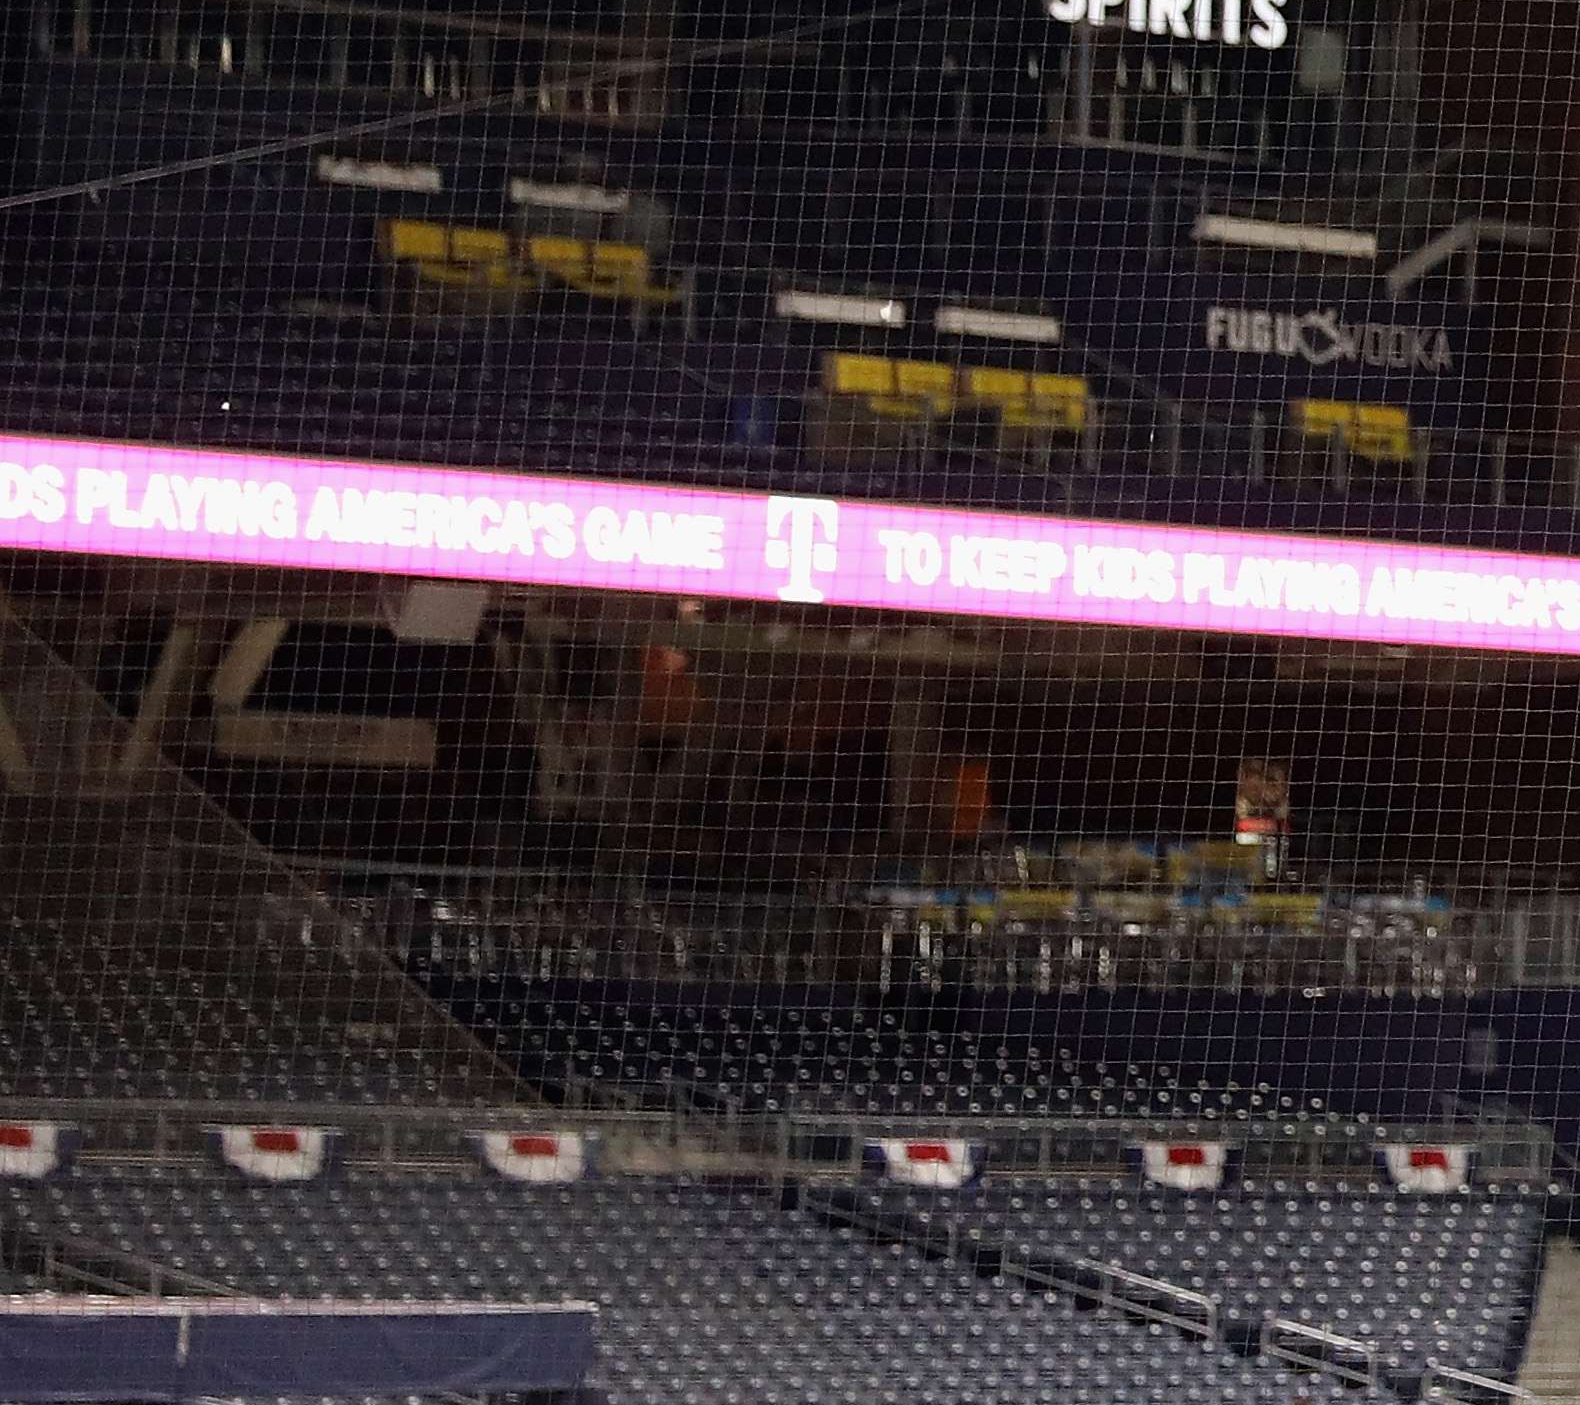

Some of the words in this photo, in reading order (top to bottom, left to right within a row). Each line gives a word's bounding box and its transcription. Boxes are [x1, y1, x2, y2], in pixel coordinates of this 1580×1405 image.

[1207, 306, 1301, 357] FUGU
[77, 468, 297, 539] PLAYING
[304, 486, 576, 559] AMERICA'S
[583, 507, 725, 569] GAME
[878, 530, 941, 586] TO
[950, 535, 1067, 597] KEEP
[1073, 544, 1175, 603] KIDS
[1183, 552, 1360, 617] PLAYING
